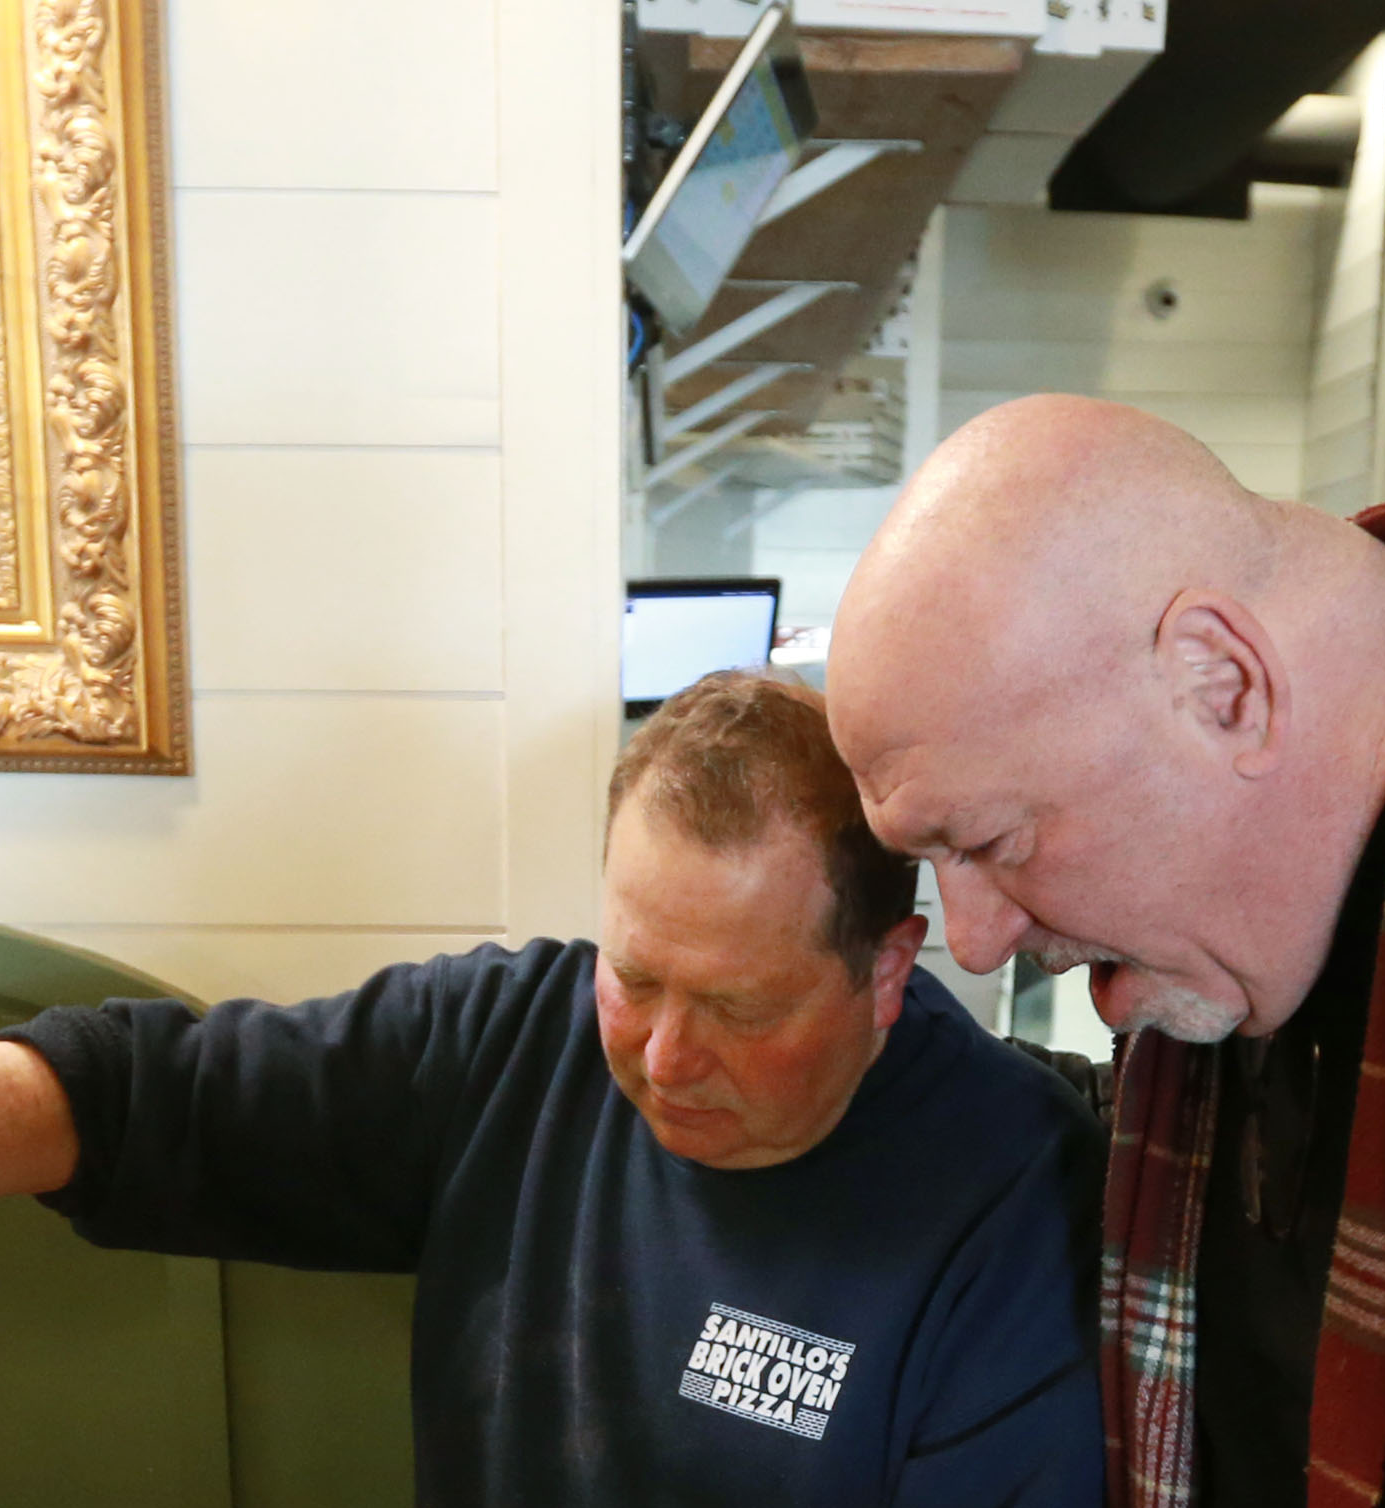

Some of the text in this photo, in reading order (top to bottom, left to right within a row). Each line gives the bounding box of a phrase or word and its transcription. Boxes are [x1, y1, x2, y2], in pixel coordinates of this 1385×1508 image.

[688, 1340, 841, 1411] BRICK OVEN
[700, 1314, 851, 1381] SANTILLO'S
[710, 1379, 796, 1425] PIZZA
